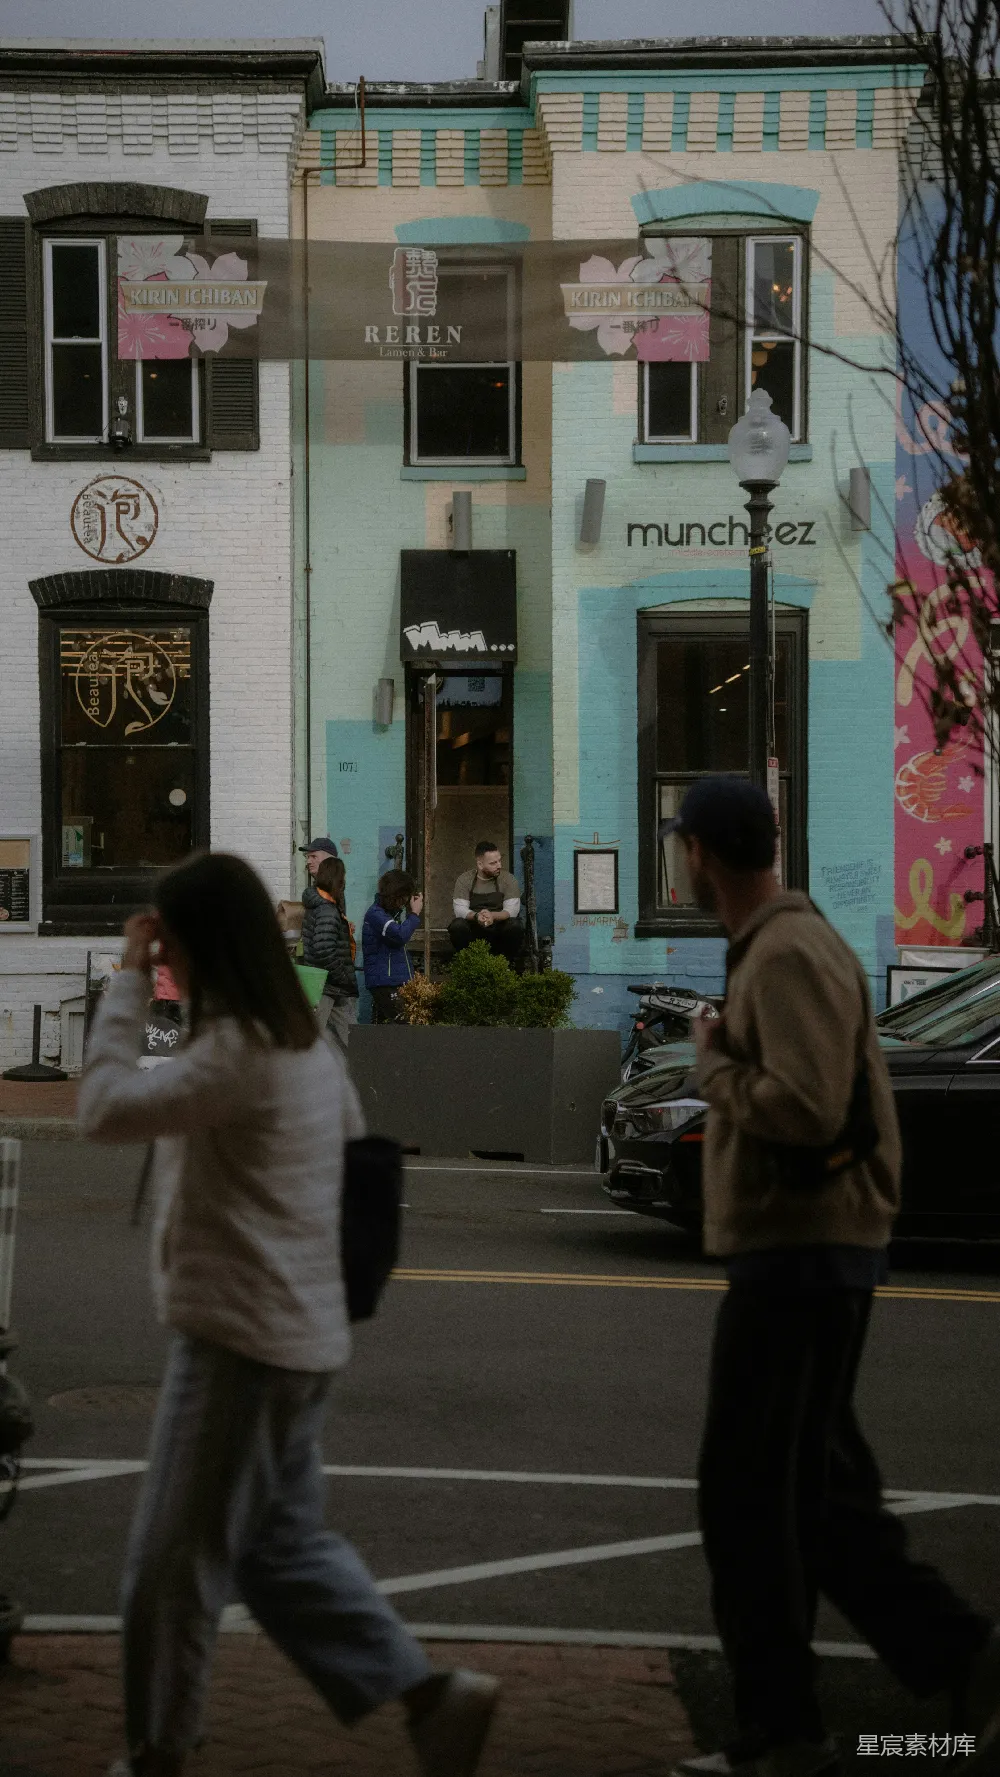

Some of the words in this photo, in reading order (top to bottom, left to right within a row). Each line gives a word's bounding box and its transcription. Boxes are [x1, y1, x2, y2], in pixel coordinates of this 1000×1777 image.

[130, 288, 180, 305] KIRIN
[184, 288, 258, 305] ICHIBAN
[571, 291, 621, 307] KIRIN
[627, 290, 700, 307] ICHIBAN
[364, 325, 462, 344] REREN
[380, 346, 415, 357] Lamen
[417, 346, 426, 357] &
[429, 346, 448, 357] Bar
[87, 653, 100, 717] Beautea
